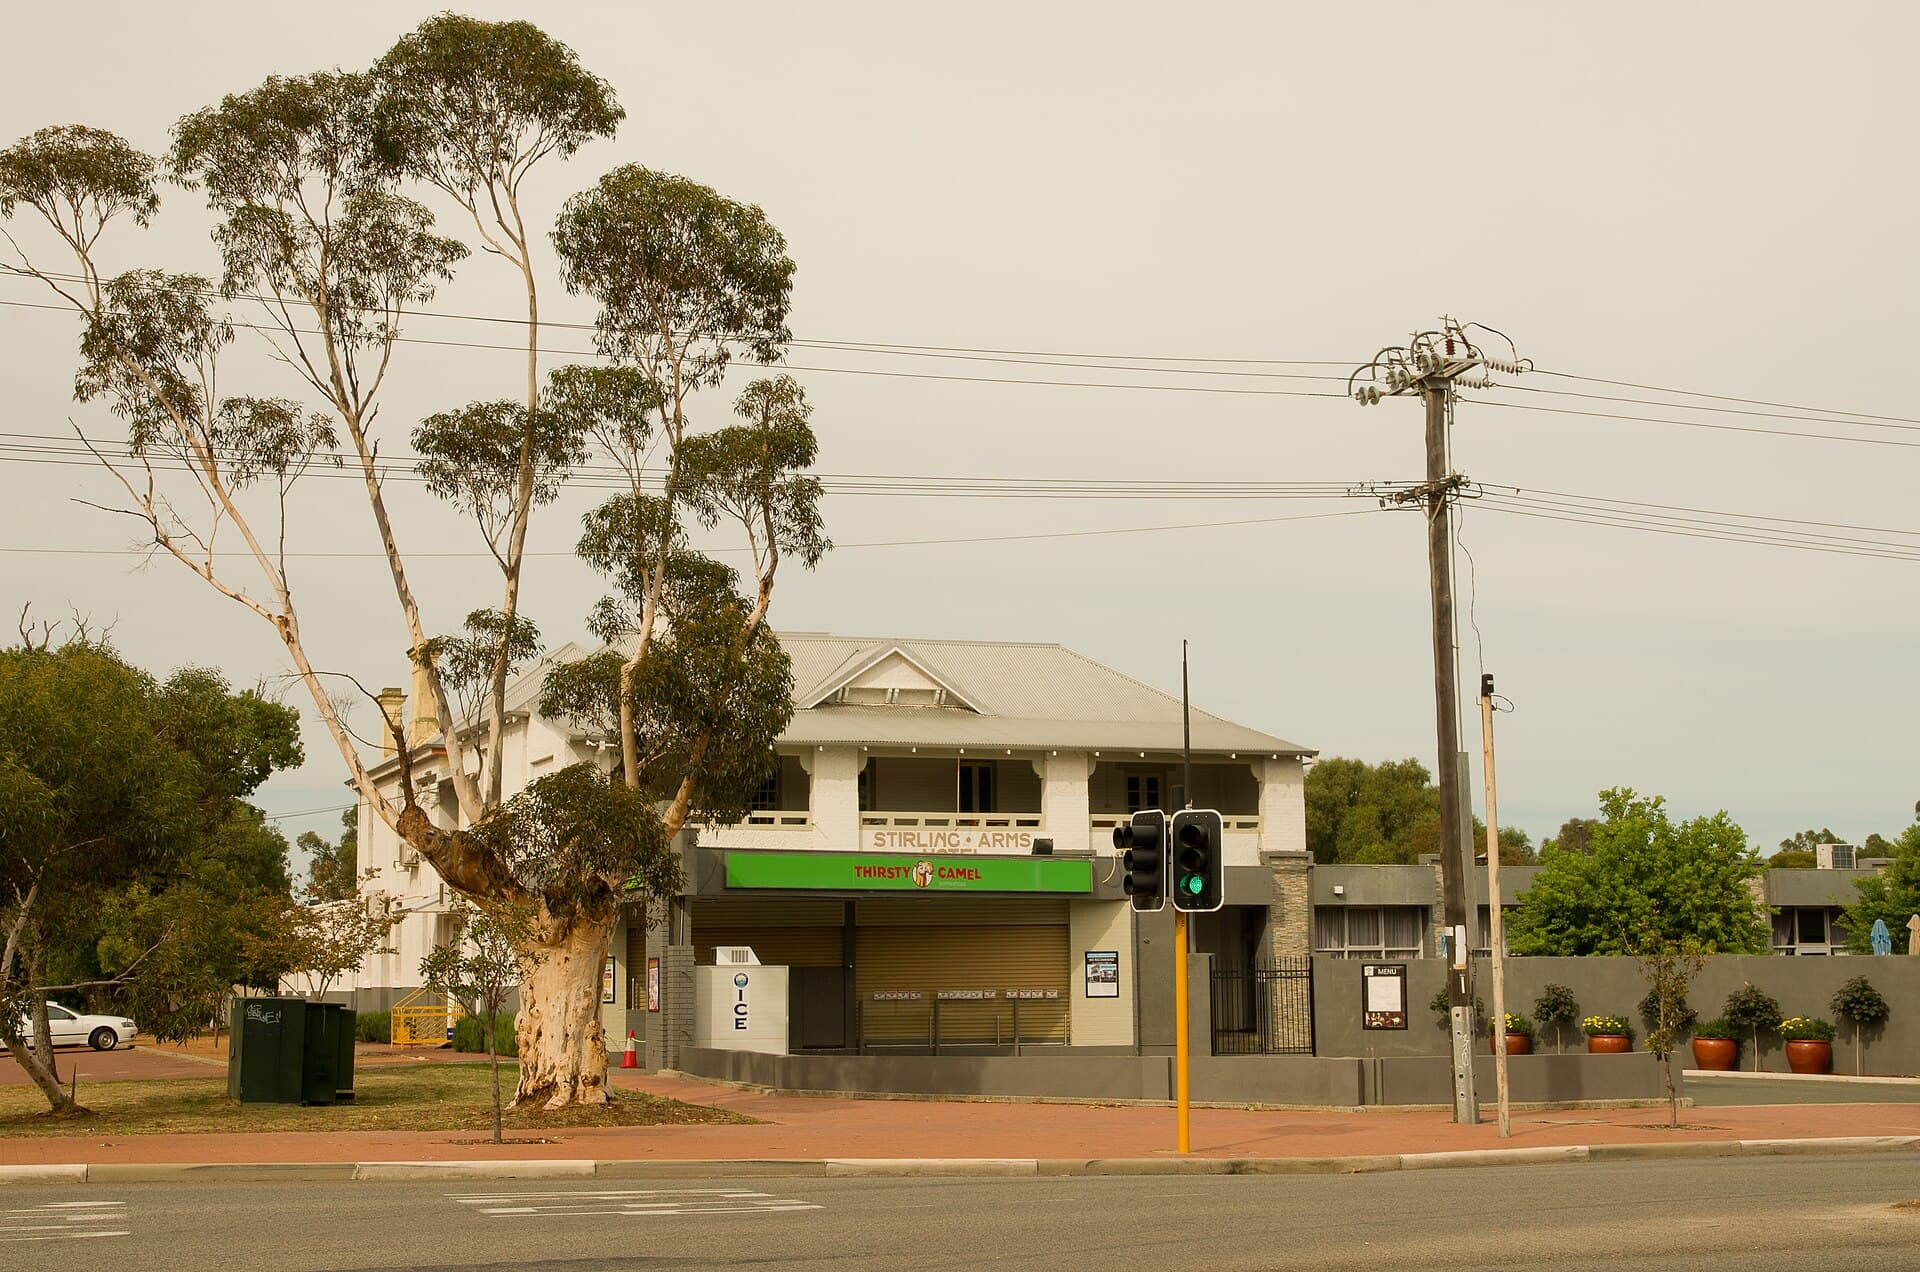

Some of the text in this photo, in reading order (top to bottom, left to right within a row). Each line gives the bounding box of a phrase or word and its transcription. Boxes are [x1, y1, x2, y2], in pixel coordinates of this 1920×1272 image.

[873, 832, 1031, 848] STIRLING ARMS
[854, 865, 982, 881] THIRSTY CAMEL
